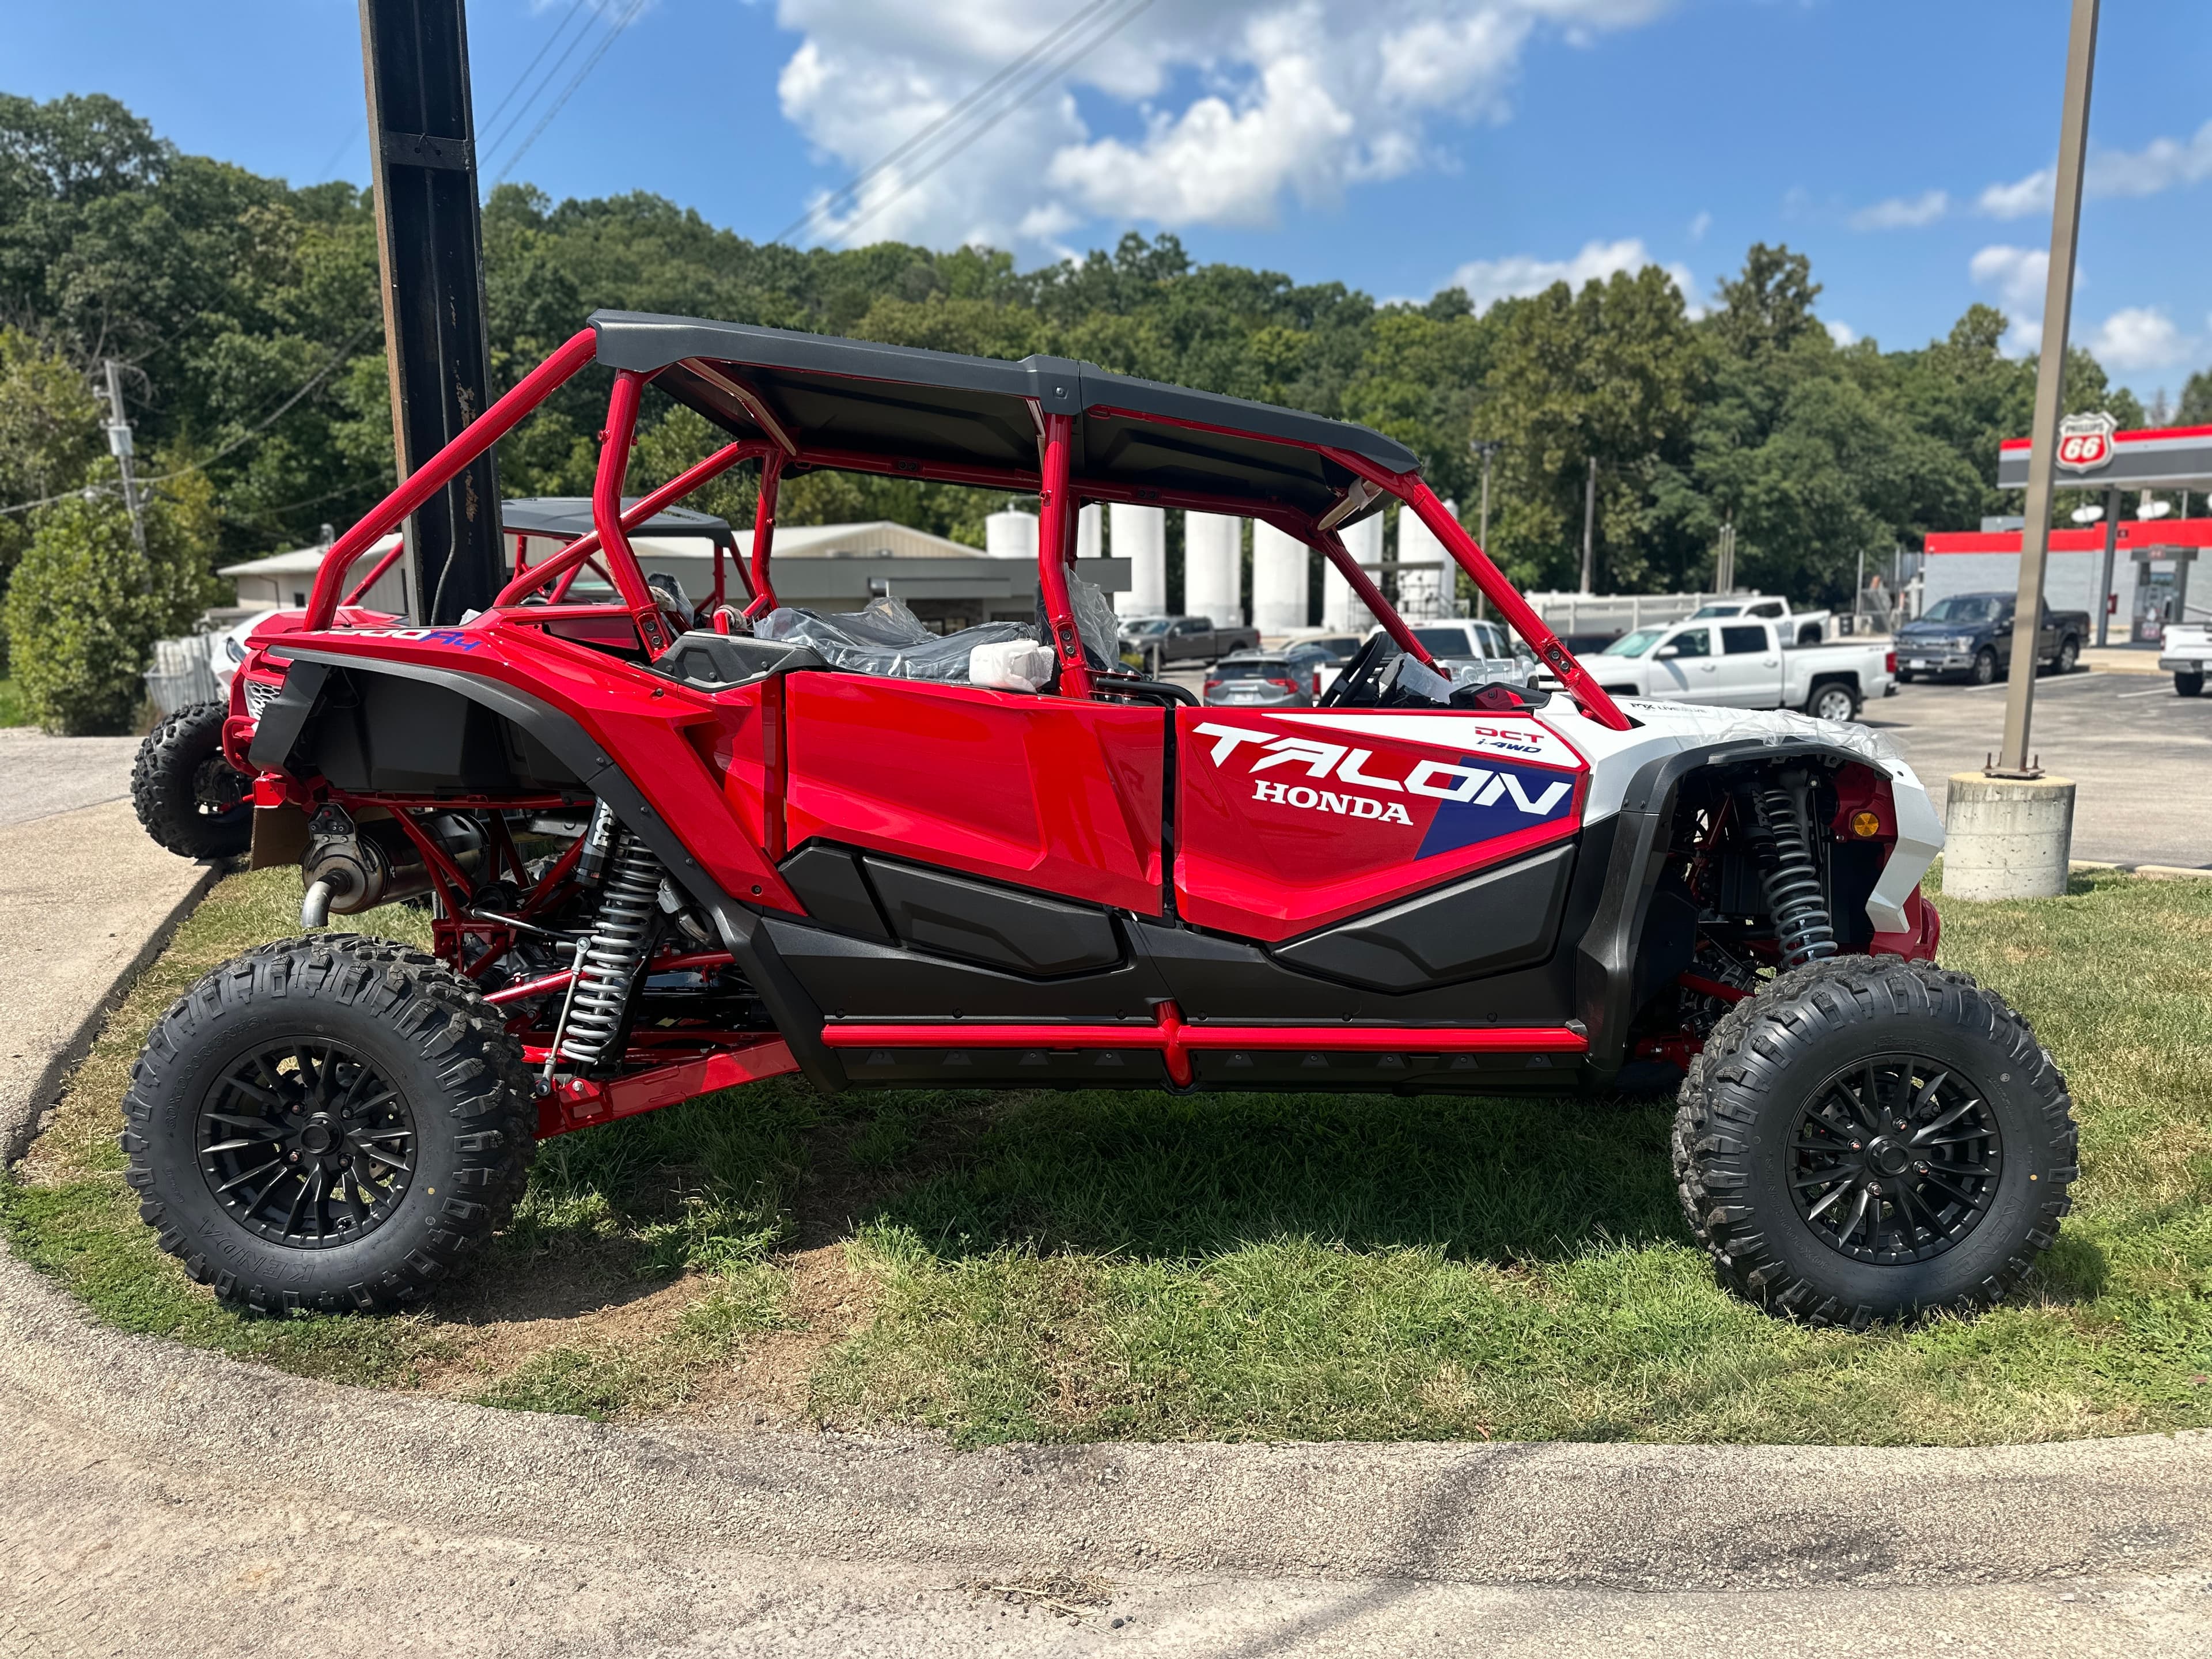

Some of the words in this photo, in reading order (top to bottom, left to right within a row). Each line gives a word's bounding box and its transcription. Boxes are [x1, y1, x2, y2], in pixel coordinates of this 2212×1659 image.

[2065, 438, 2101, 460] 66
[1475, 726, 1545, 743] DCT
[1192, 722, 1573, 816] TALON
[1252, 779, 1414, 827] HONDA
[198, 1217, 316, 1283] KENDA
[1931, 1194, 2027, 1287] KENDA
